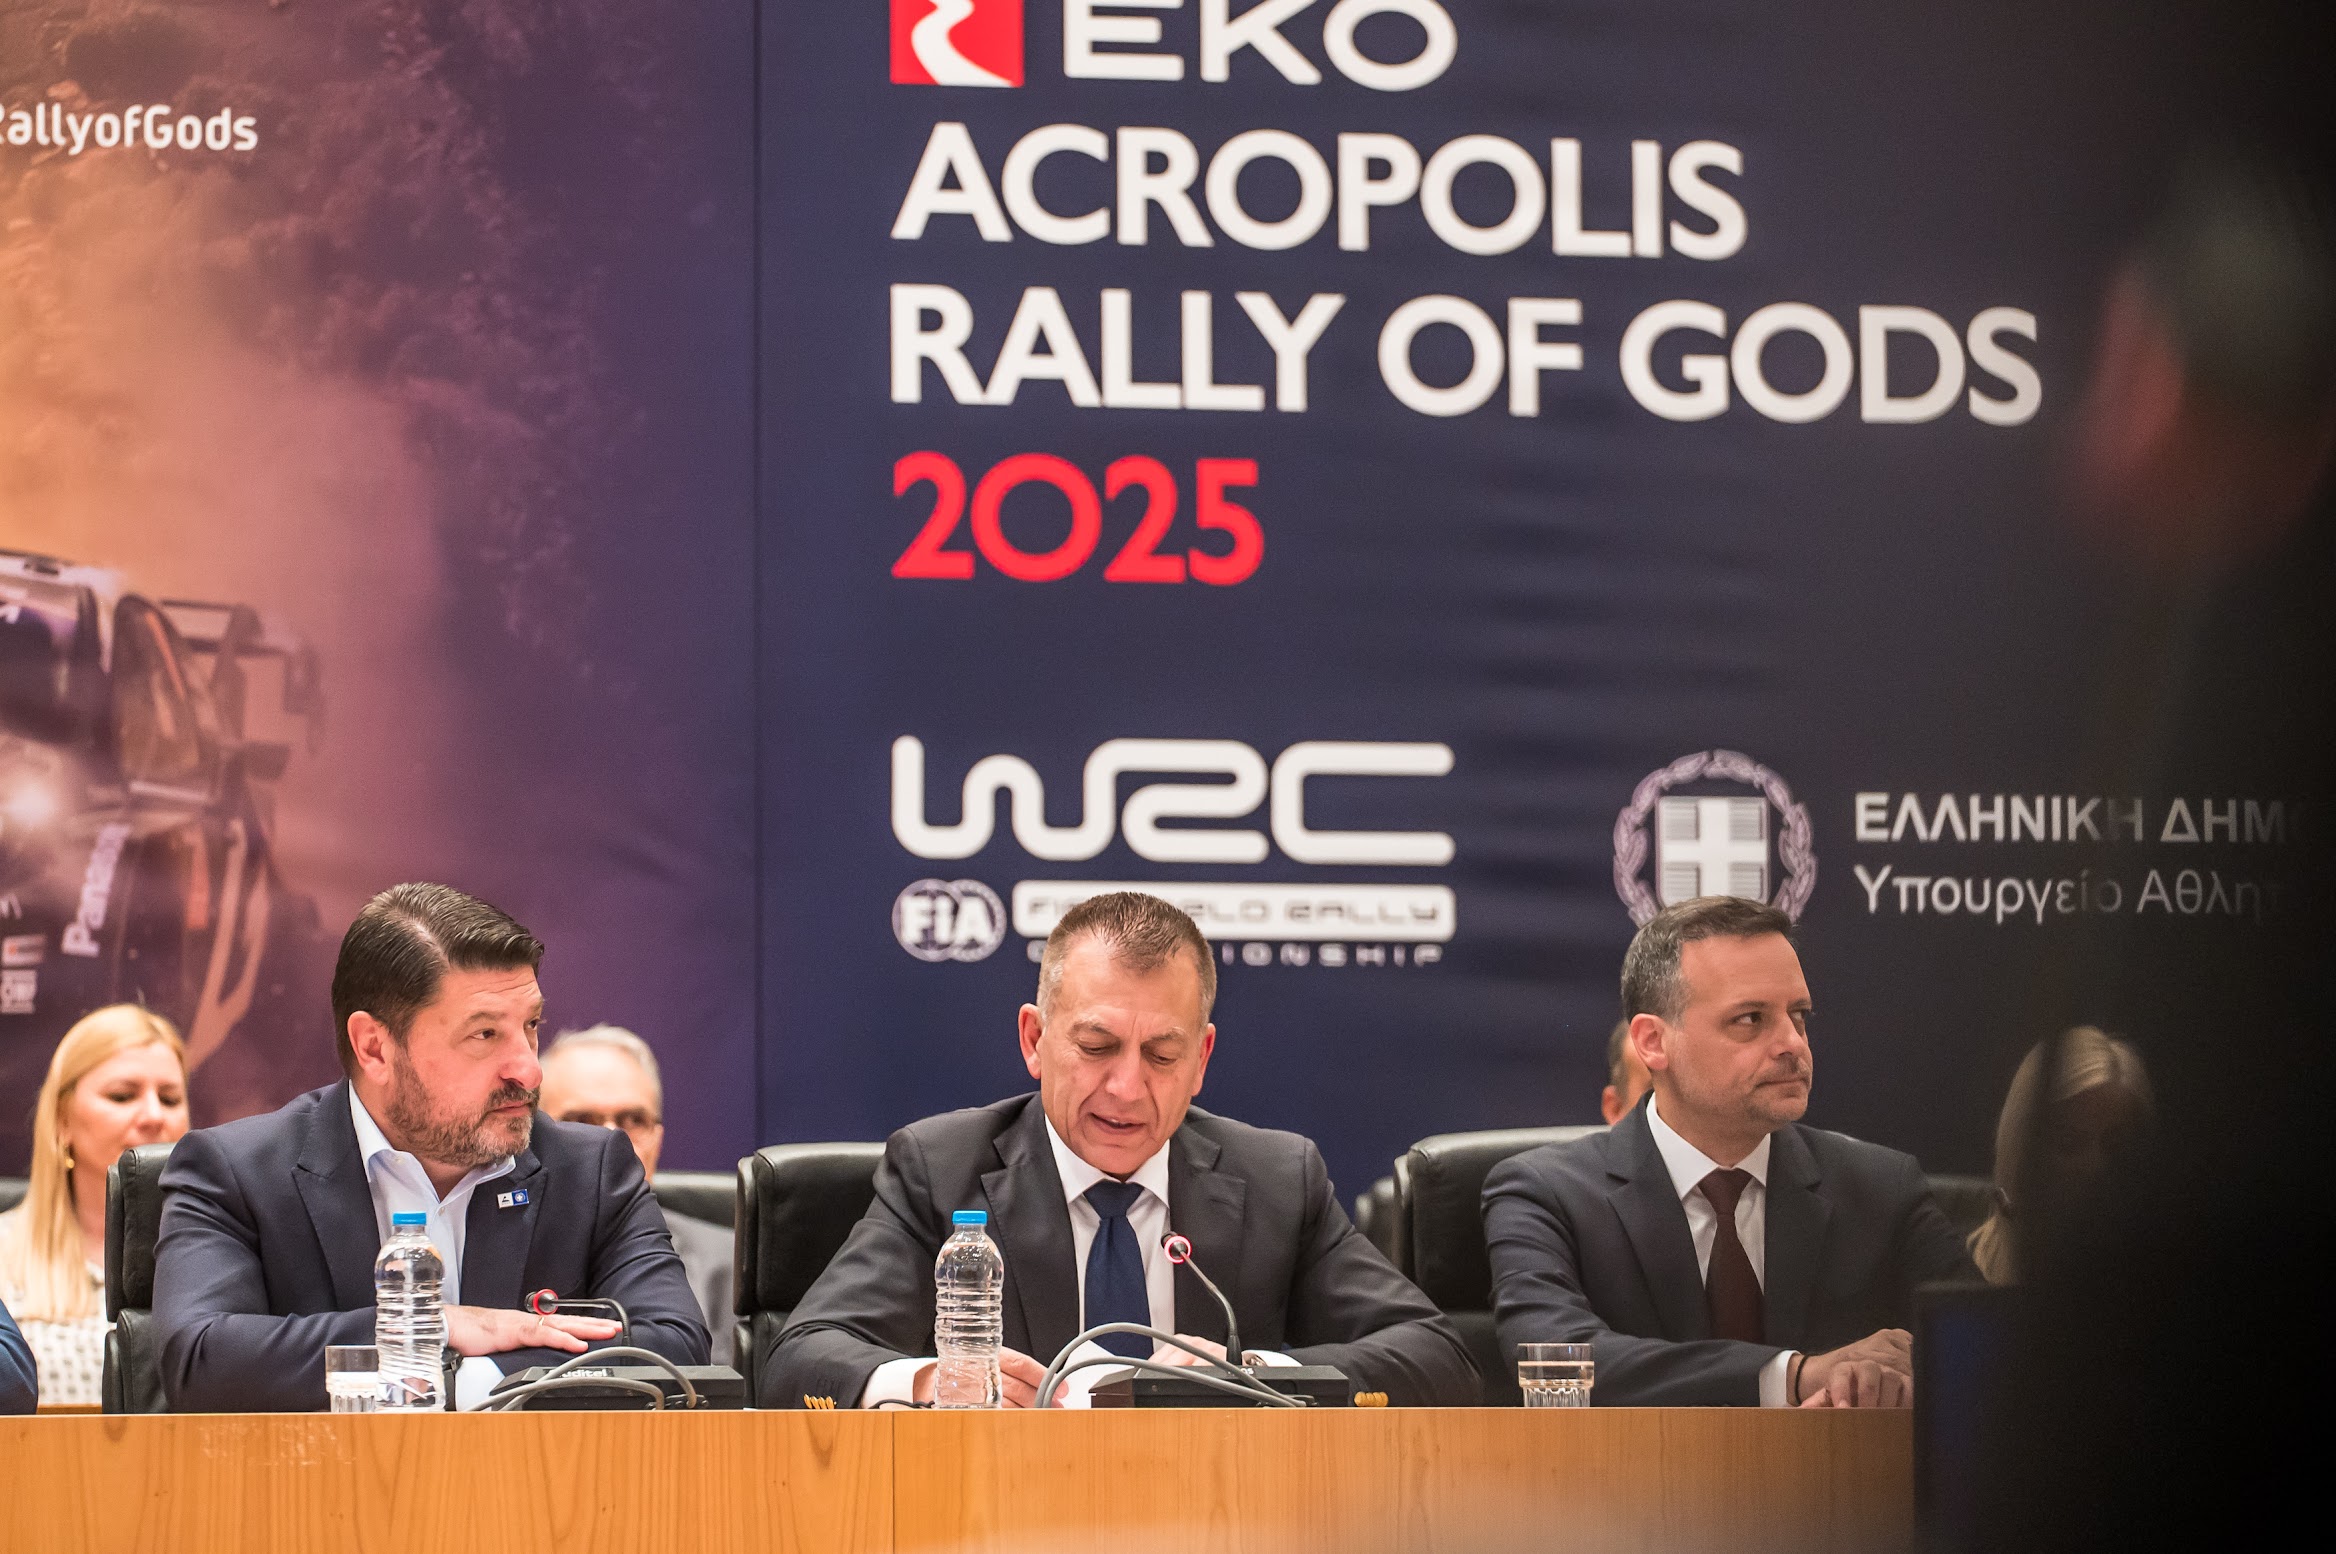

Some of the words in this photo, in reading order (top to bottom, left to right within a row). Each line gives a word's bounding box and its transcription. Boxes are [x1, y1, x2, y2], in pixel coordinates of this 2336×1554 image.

[1063, 0, 1458, 91] EKO
[890, 122, 1748, 260] ACROPOLIS
[890, 283, 1346, 412] RALLY
[1378, 295, 1583, 417] OF
[1619, 300, 2042, 425] GODS
[891, 450, 1266, 586] 2025
[891, 735, 1455, 865] WRC
[1853, 791, 2146, 844] ΕΛΛΗΝΙΚΗ
[2159, 796, 2304, 845] ΔΗΜ
[900, 895, 996, 947] FIA
[1853, 863, 2123, 926] Υπουργείο
[557, 1367, 608, 1378] uditel
